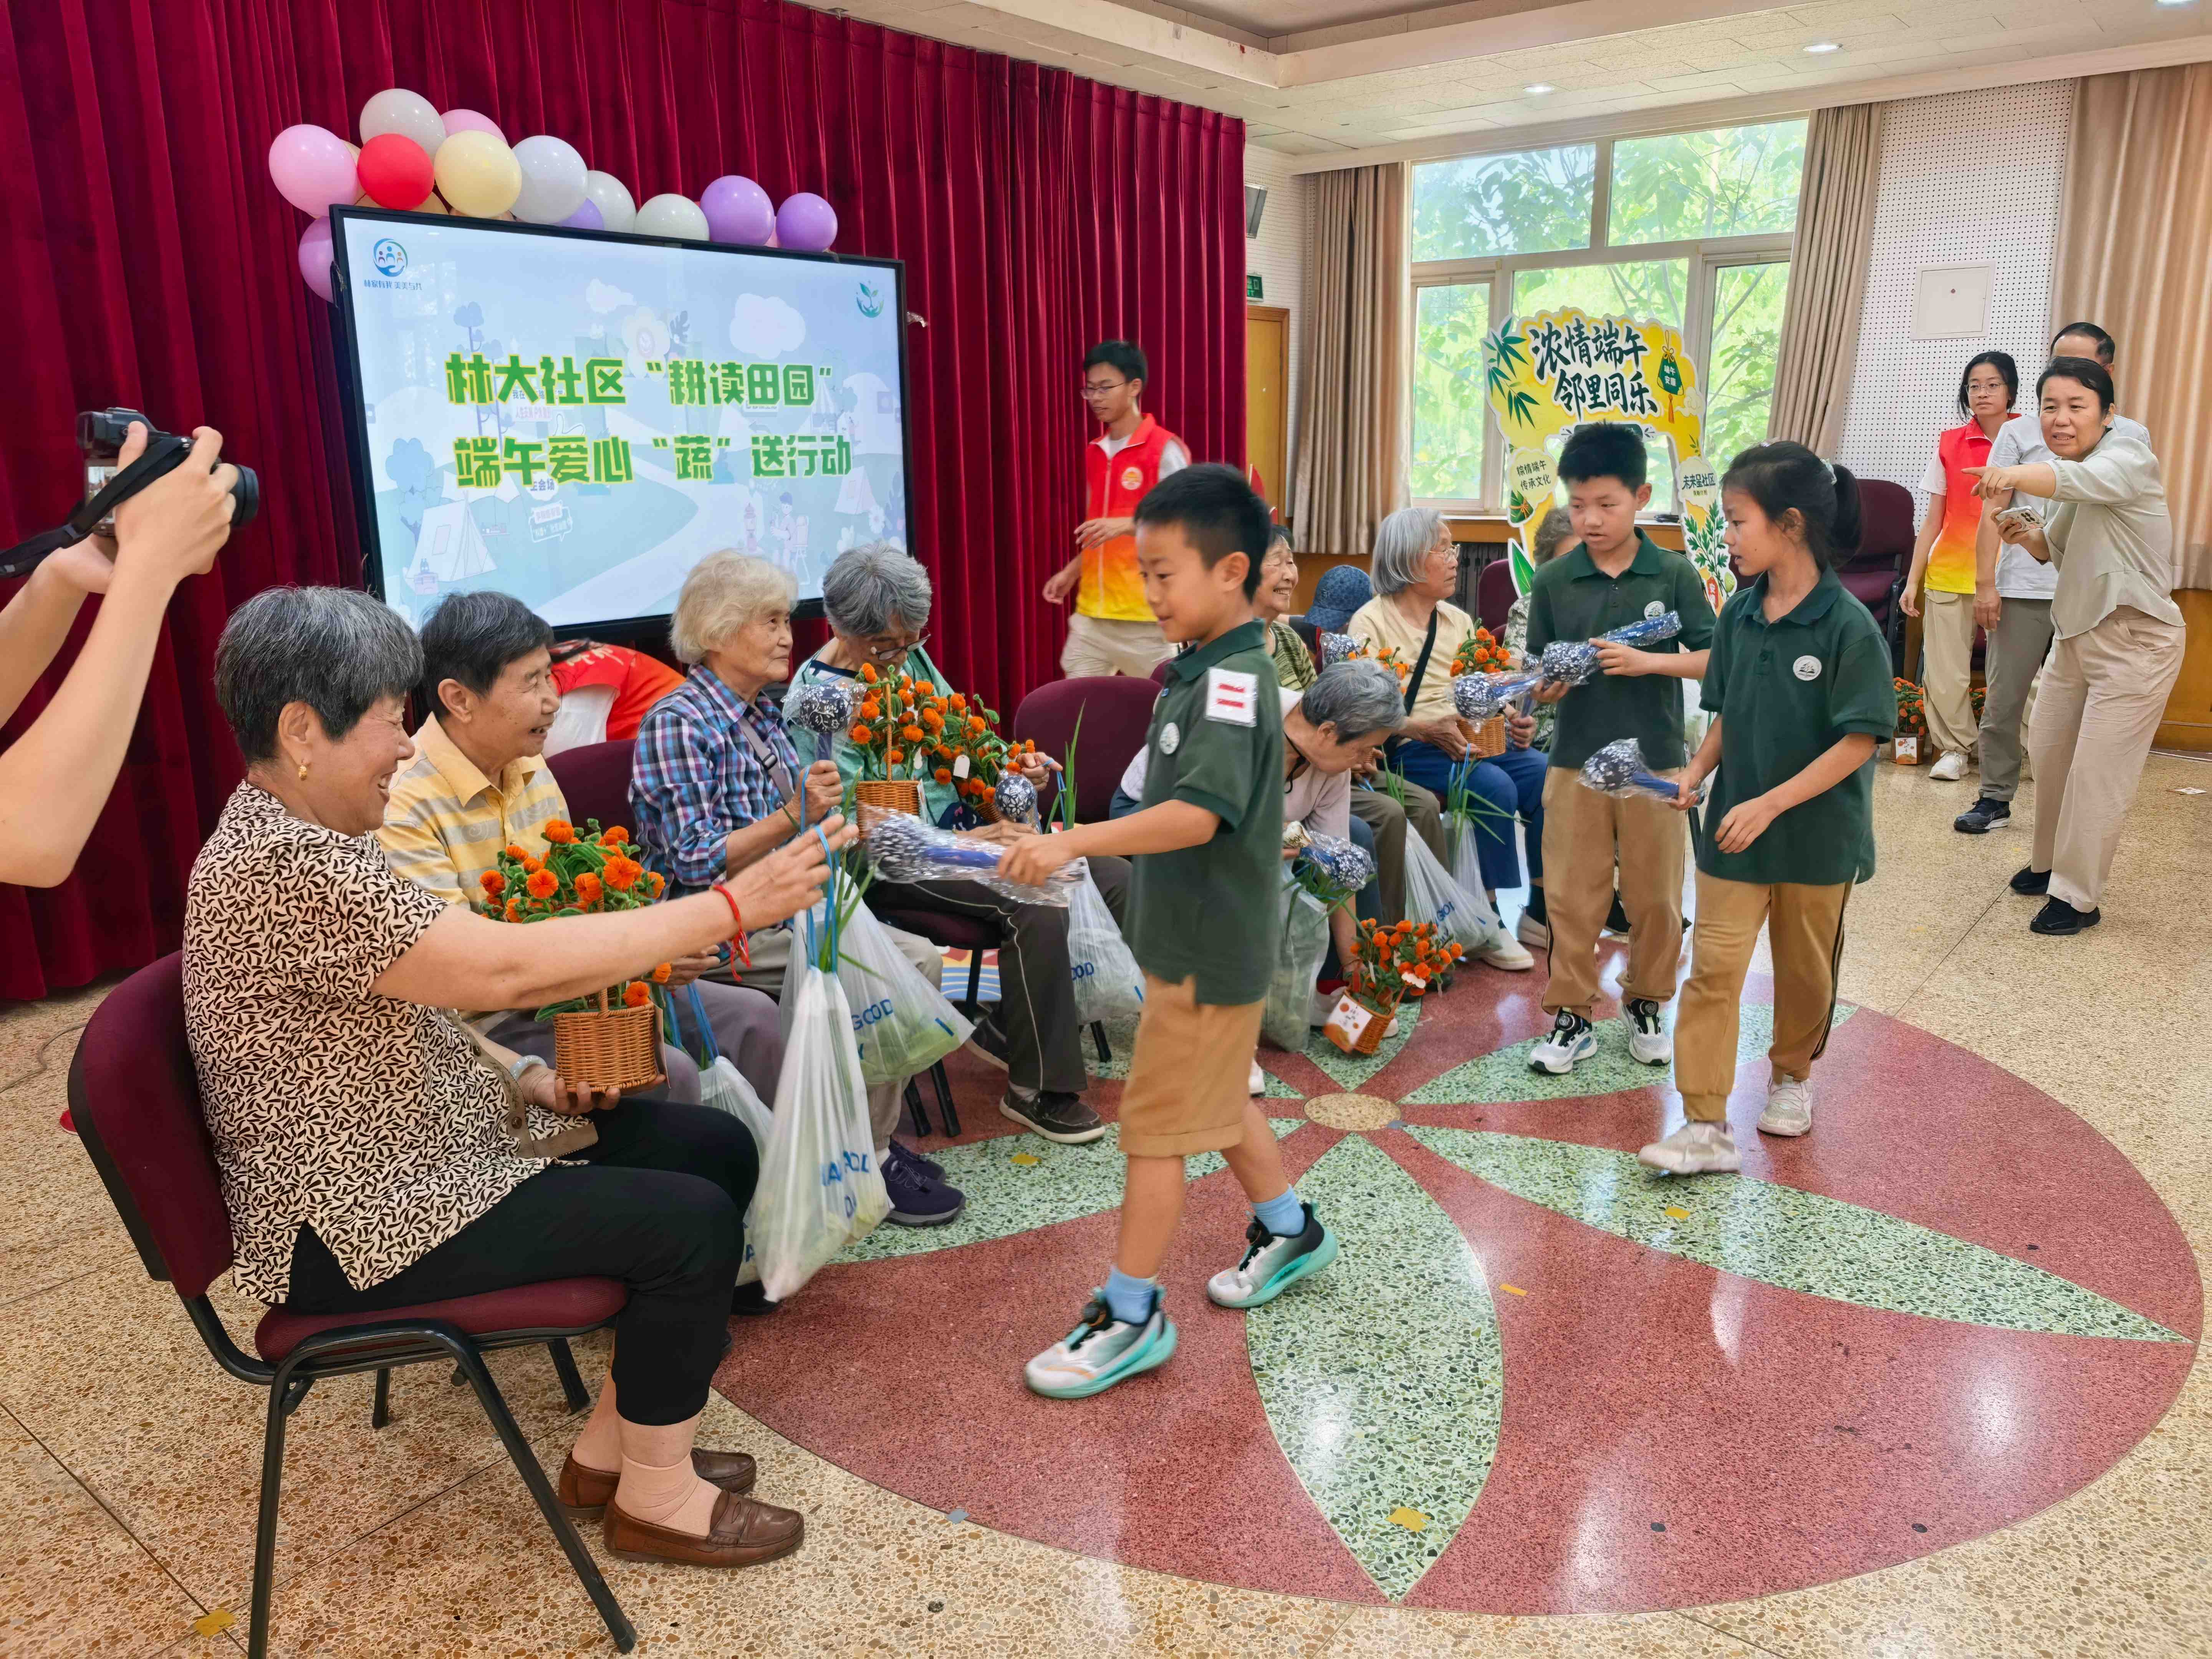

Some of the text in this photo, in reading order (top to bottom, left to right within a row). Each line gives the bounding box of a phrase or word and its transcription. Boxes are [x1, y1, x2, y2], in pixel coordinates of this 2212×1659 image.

[363, 279, 391, 289] 林家有我
[1528, 318, 1648, 381] 浓情端午
[1554, 371, 1658, 422] 邻里同乐
[1516, 460, 1546, 477] 粽情端午
[1520, 474, 1551, 491] 传承文化
[1682, 473, 1716, 490] 未来星社区
[851, 998, 894, 1031] GOOD
